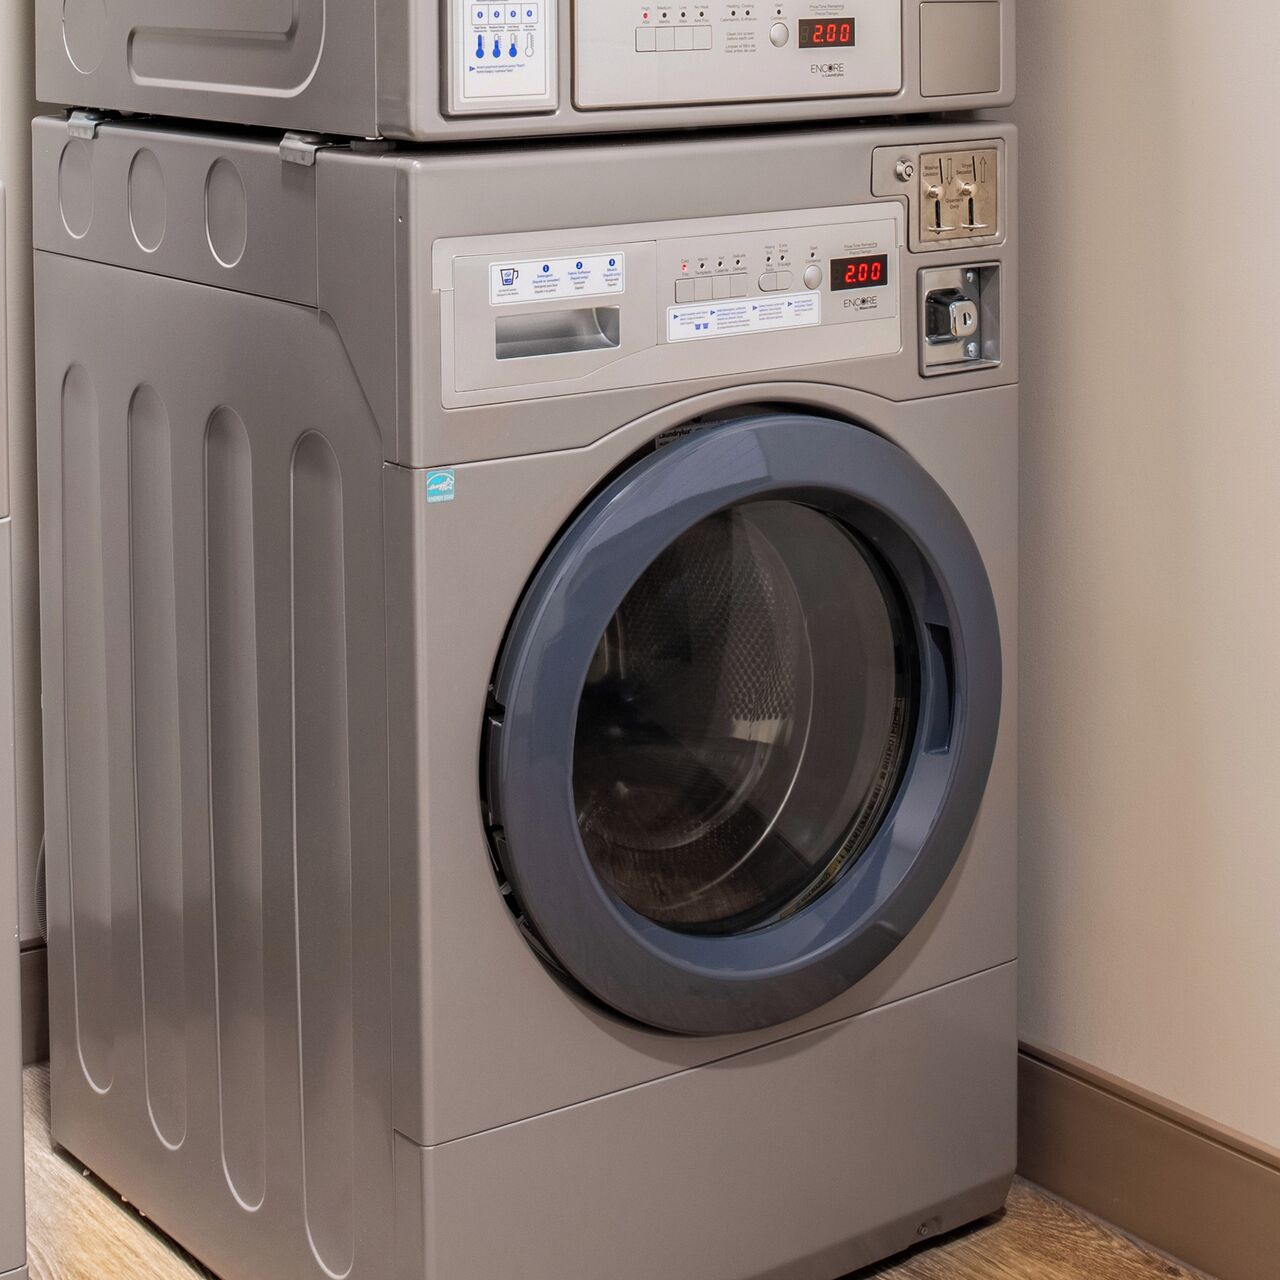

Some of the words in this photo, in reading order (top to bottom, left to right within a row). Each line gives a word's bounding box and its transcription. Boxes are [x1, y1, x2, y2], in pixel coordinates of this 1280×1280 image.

[813, 24, 850, 42] 2.00
[810, 63, 844, 73] ENCORE
[845, 262, 881, 283] 2.00
[844, 296, 877, 308] ENCORE
